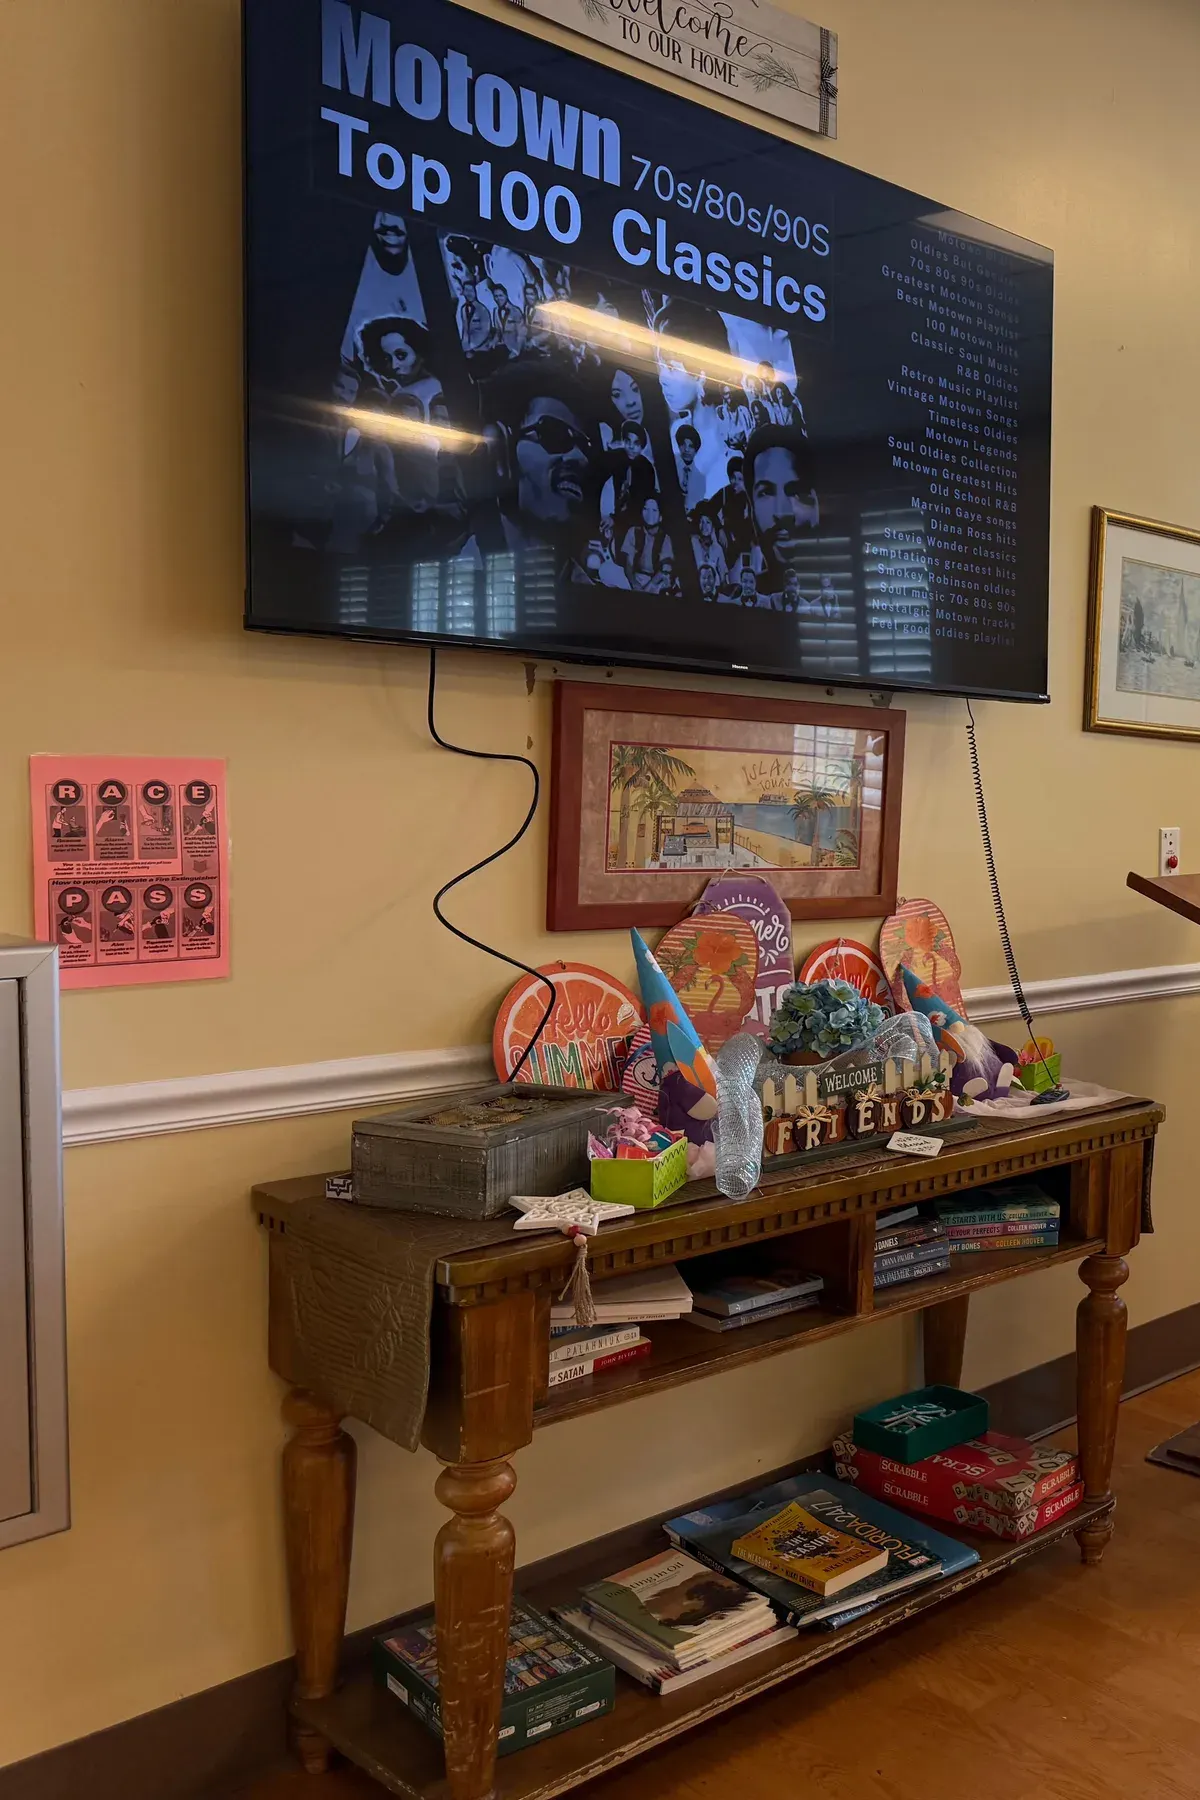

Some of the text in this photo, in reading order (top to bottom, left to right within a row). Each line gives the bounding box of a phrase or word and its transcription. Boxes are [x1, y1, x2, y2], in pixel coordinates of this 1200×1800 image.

[618, 15, 739, 88] TO OUR HOME
[321, 0, 622, 186] Motown
[321, 107, 827, 323] Top 100 Classics
[911, 238, 949, 262] Oldies
[953, 254, 972, 271] But
[909, 256, 931, 273] 70s
[935, 266, 956, 283] 80s
[961, 275, 981, 292] 90s
[881, 264, 1019, 324] Greatest Motown Songs
[897, 289, 1019, 340] Best Motown Playlist
[926, 318, 1019, 359] 100 Motown Hits
[911, 332, 1019, 376] Classic Soul Music
[901, 365, 1019, 410] Retro Music Playlist
[957, 365, 1019, 393] R&B Oldies
[887, 379, 1018, 428] Vintage Motown Songs
[928, 410, 1018, 444] Timeless Oldies
[887, 436, 1017, 479] Soul Oldies Collection
[925, 427, 1018, 462] Motown Legends
[892, 455, 1017, 496] Motown Greatest Hits
[930, 483, 1017, 512] Old School R&B
[911, 497, 1017, 530] Marvin Gaye songs
[884, 527, 1017, 563] Stevie Wonder classics
[930, 519, 1017, 546] Diana Ross hits
[864, 542, 1016, 580] Temptations greatest hits
[877, 563, 1016, 597] Smokey Robinson oldies
[880, 581, 1015, 613] Soul music 70s 80s 90s
[871, 617, 898, 631] Feel
[903, 623, 931, 636] good
[935, 628, 970, 641] oldies
[872, 599, 1015, 631] Nostalgic Motown tracks
[759, 778, 791, 791] TOURS
[82, 878, 117, 886] properly
[117, 877, 146, 885] operate
[534, 1001, 612, 1041] Hello
[509, 1035, 634, 1090] SUMME
[825, 1066, 878, 1093] WELCOME
[775, 1090, 945, 1155] FRIENDS
[952, 1212, 1007, 1224] STARTS WITH US
[1007, 1222, 1047, 1233] COLLEEN HOOVER
[1008, 1211, 1029, 1220] COLLEEN
[878, 1237, 899, 1251] DANIELS
[955, 1226, 1001, 1236] YOUR PERFECTS
[995, 1236, 1045, 1248] COLLEEN HOOVER
[949, 1243, 961, 1252] ART
[961, 1242, 981, 1251] BONES
[566, 1334, 621, 1358] PALAHNIUK
[557, 1364, 586, 1383] SATAN
[600, 1356, 617, 1367] JOHN
[881, 1459, 928, 1483] SCRABBLE
[1041, 1465, 1077, 1495] SCRABBLE
[883, 1482, 929, 1506] SCRABBLE
[1045, 1489, 1080, 1518] SCRABBLE
[811, 1500, 855, 1524] 24/7
[779, 1531, 840, 1562] MEASURE
[785, 1534, 805, 1550] THE
[845, 1514, 920, 1561] FLORIDA
[667, 1561, 684, 1573] Oil
[736, 1547, 773, 1571] THE MEASURE
[822, 1560, 841, 1573] NIKKI
